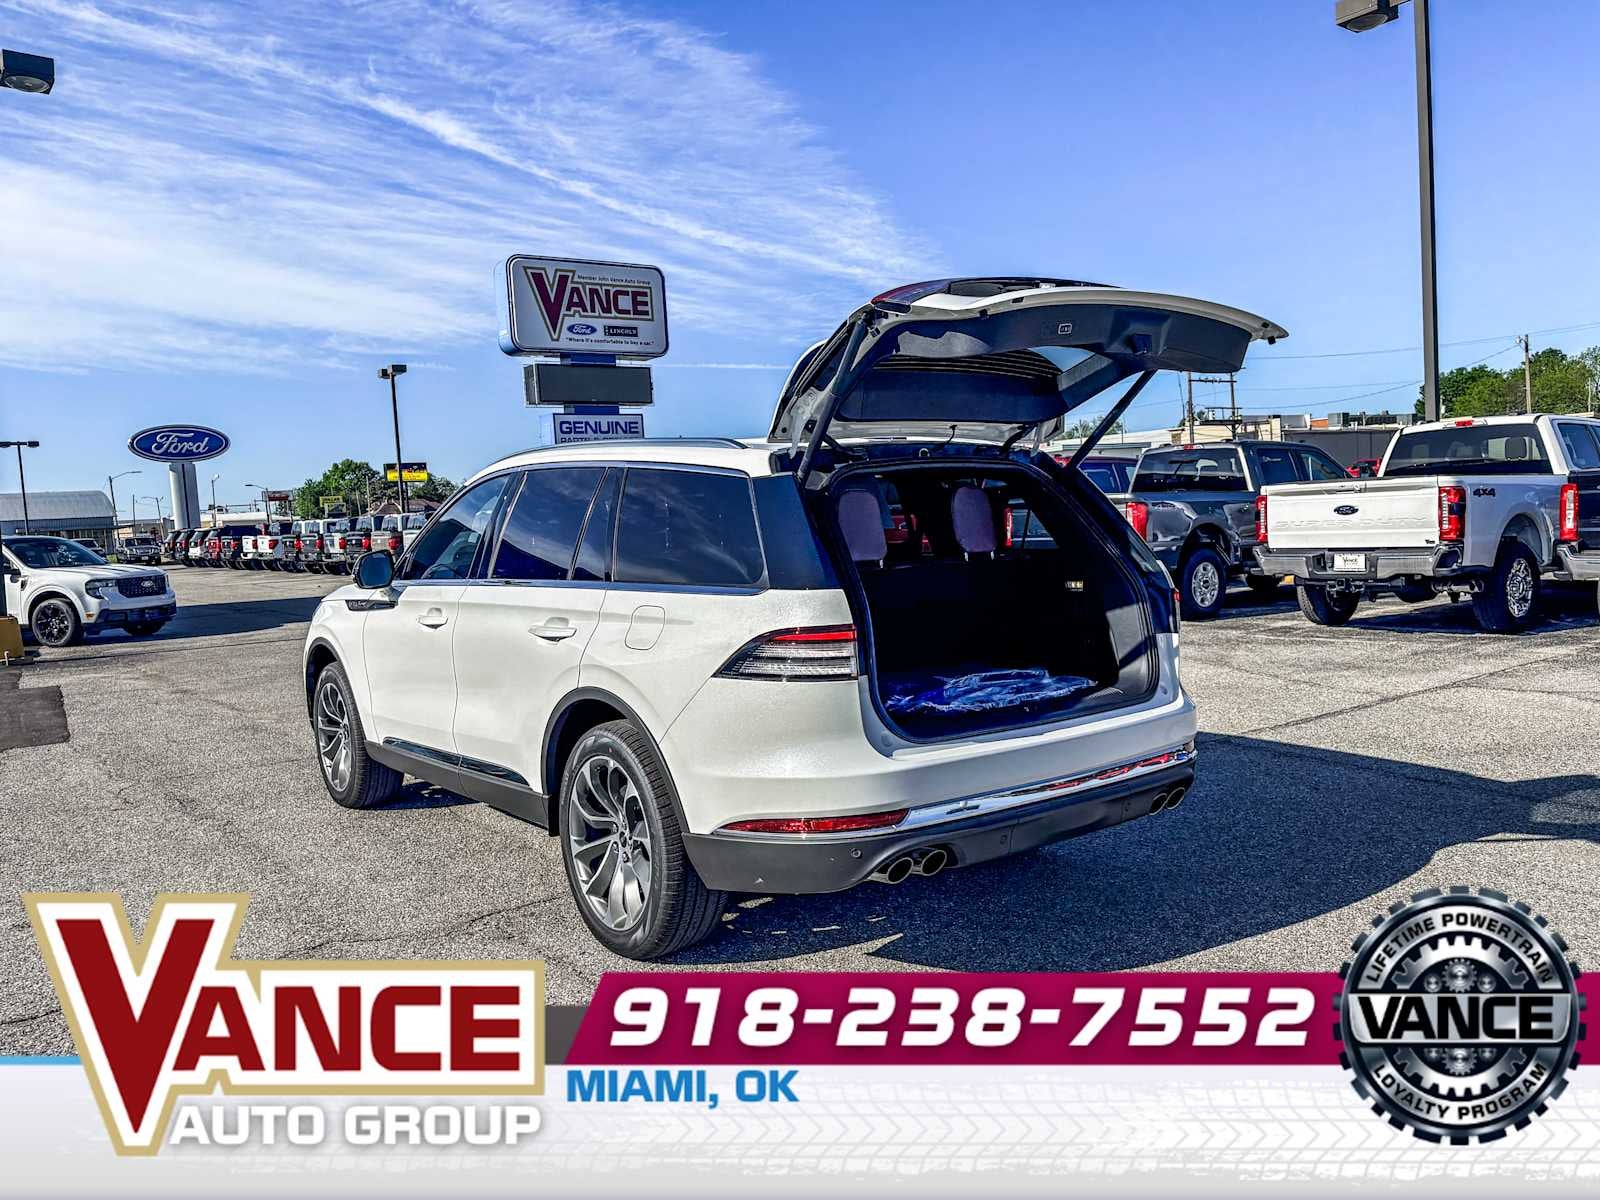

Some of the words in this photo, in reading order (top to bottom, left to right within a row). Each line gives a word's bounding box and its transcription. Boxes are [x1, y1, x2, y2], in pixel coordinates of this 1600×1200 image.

[529, 271, 650, 334] VANCE
[572, 324, 592, 334] Ford
[560, 420, 639, 434] GENUINE
[151, 432, 209, 454] Ford
